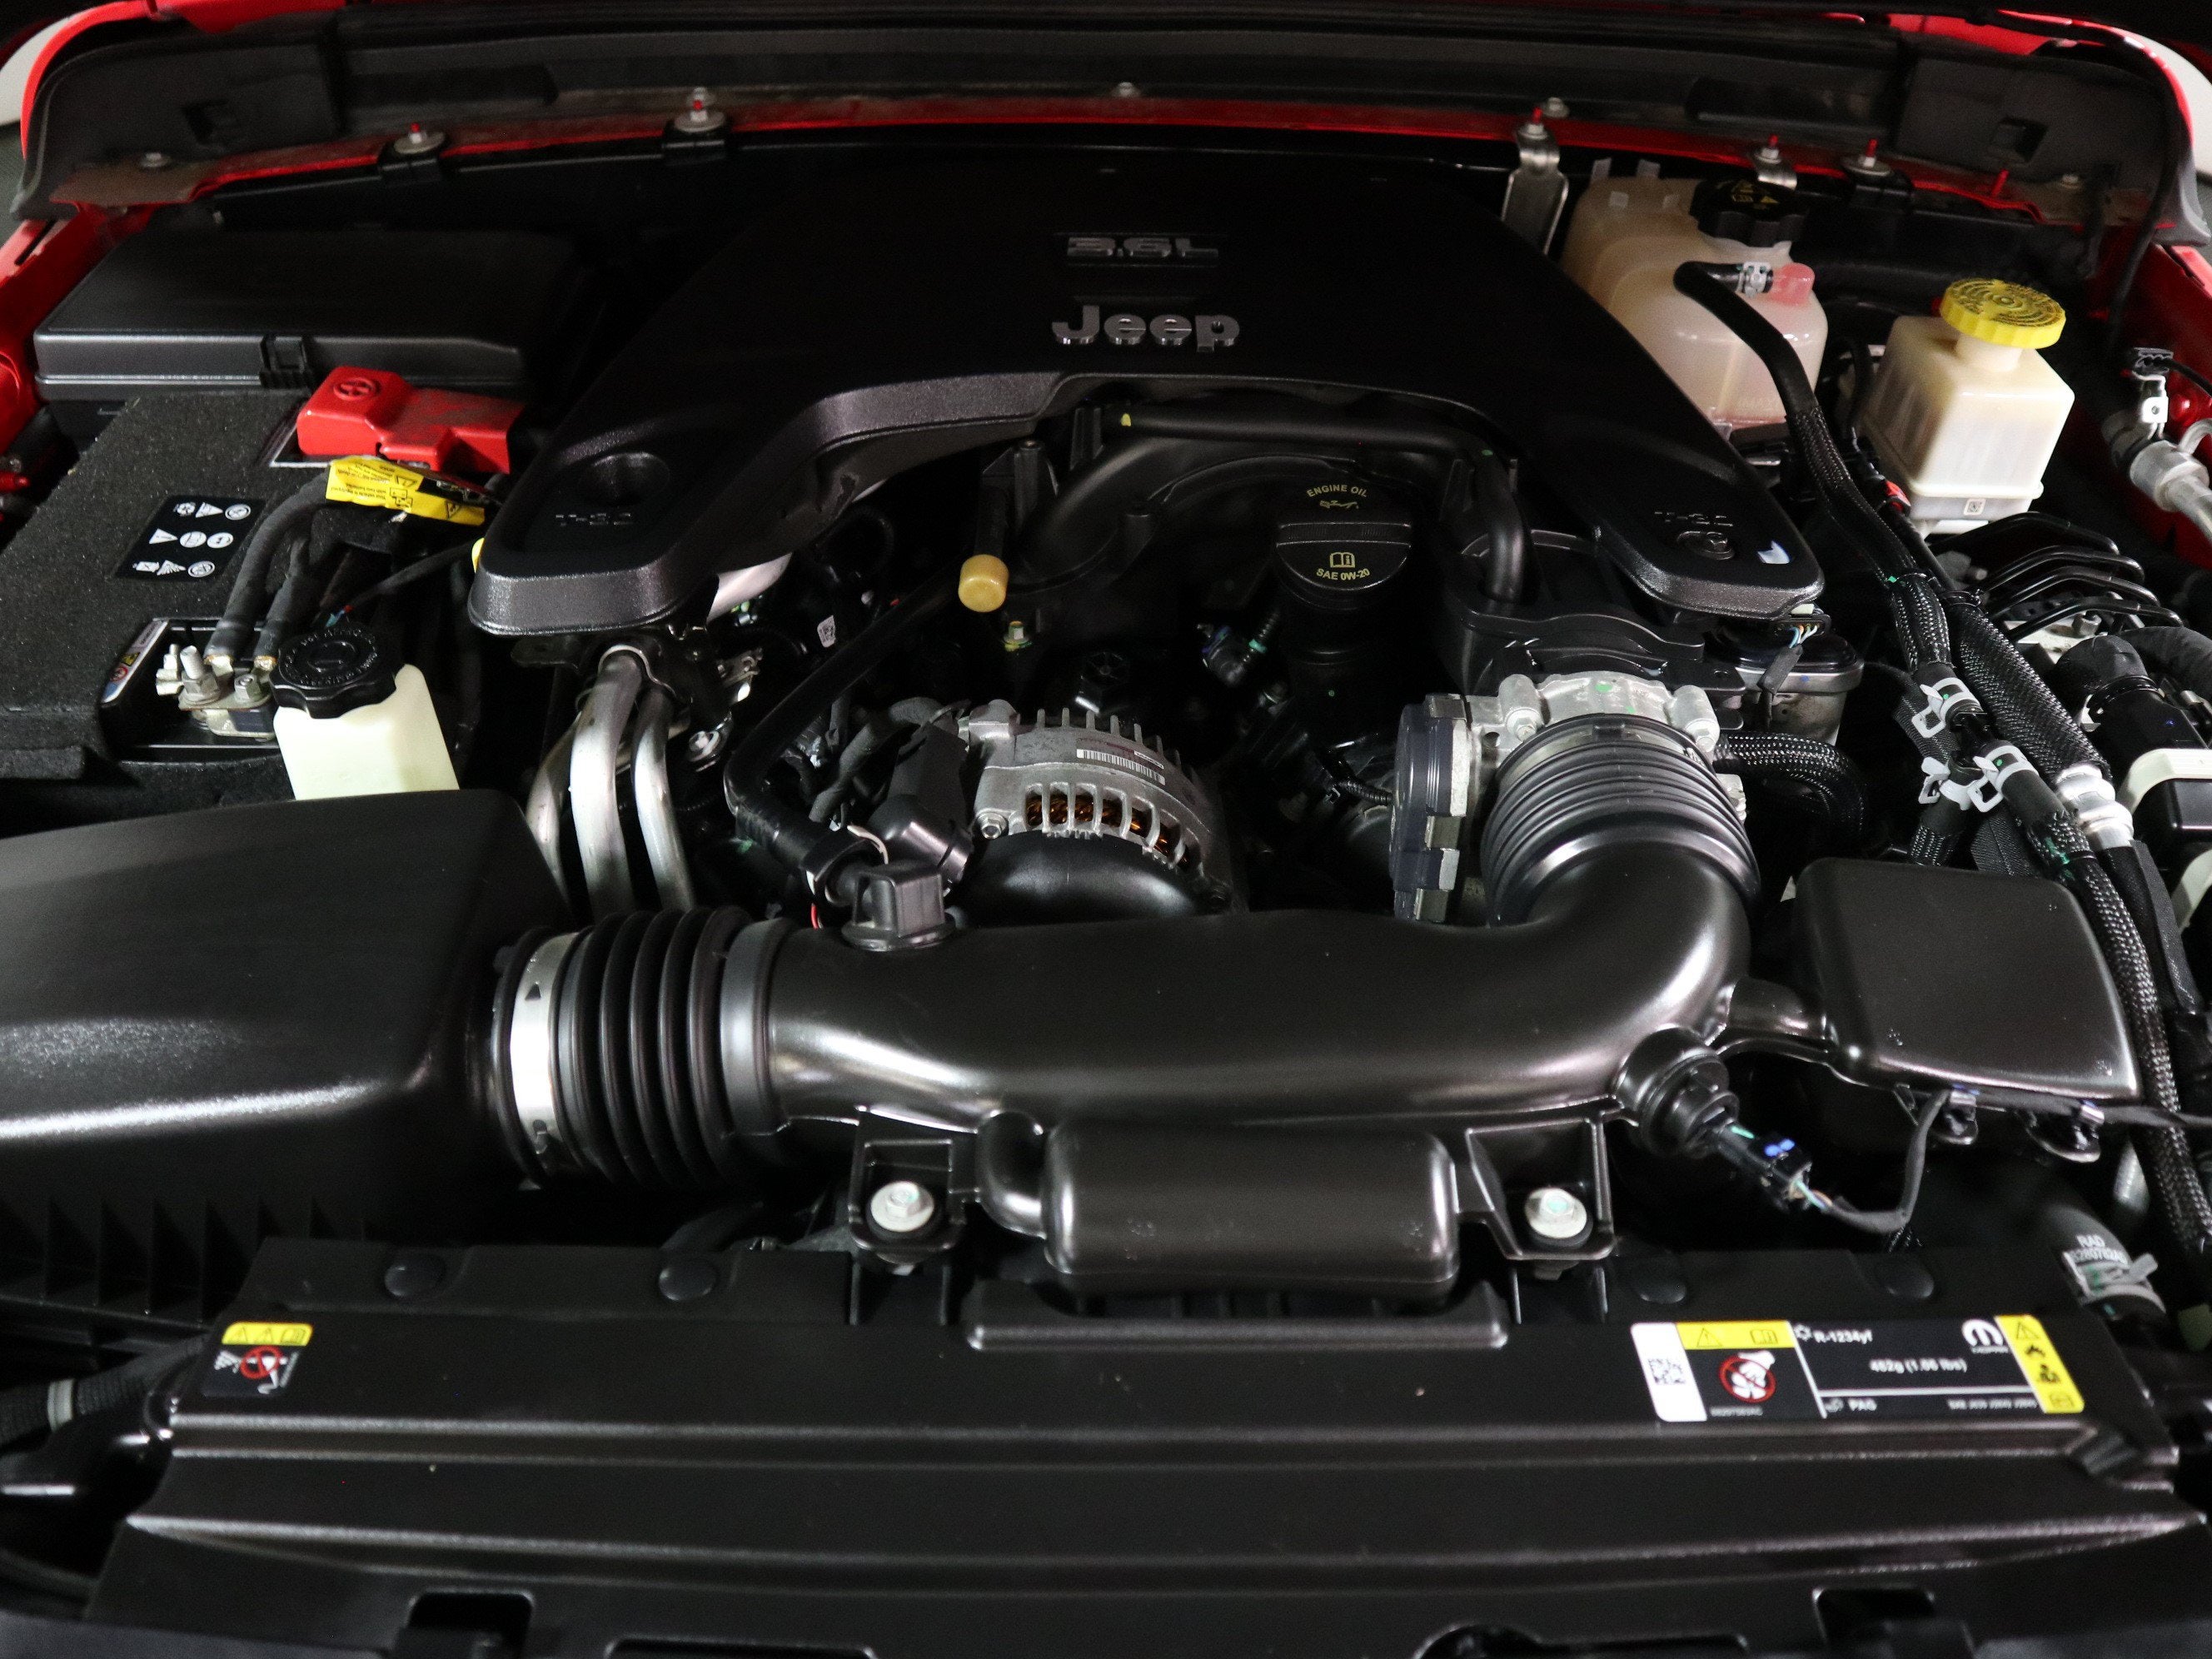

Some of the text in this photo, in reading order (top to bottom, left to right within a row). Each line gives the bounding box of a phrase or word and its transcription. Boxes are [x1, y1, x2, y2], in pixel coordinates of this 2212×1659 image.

[1067, 237, 1219, 257] 3.6L
[1051, 305, 1240, 352] Jeep
[1306, 484, 1368, 497] ENGINE OIL
[1316, 568, 1370, 580] SAE 0W-20
[1813, 1328, 1873, 1345] R-1234yf
